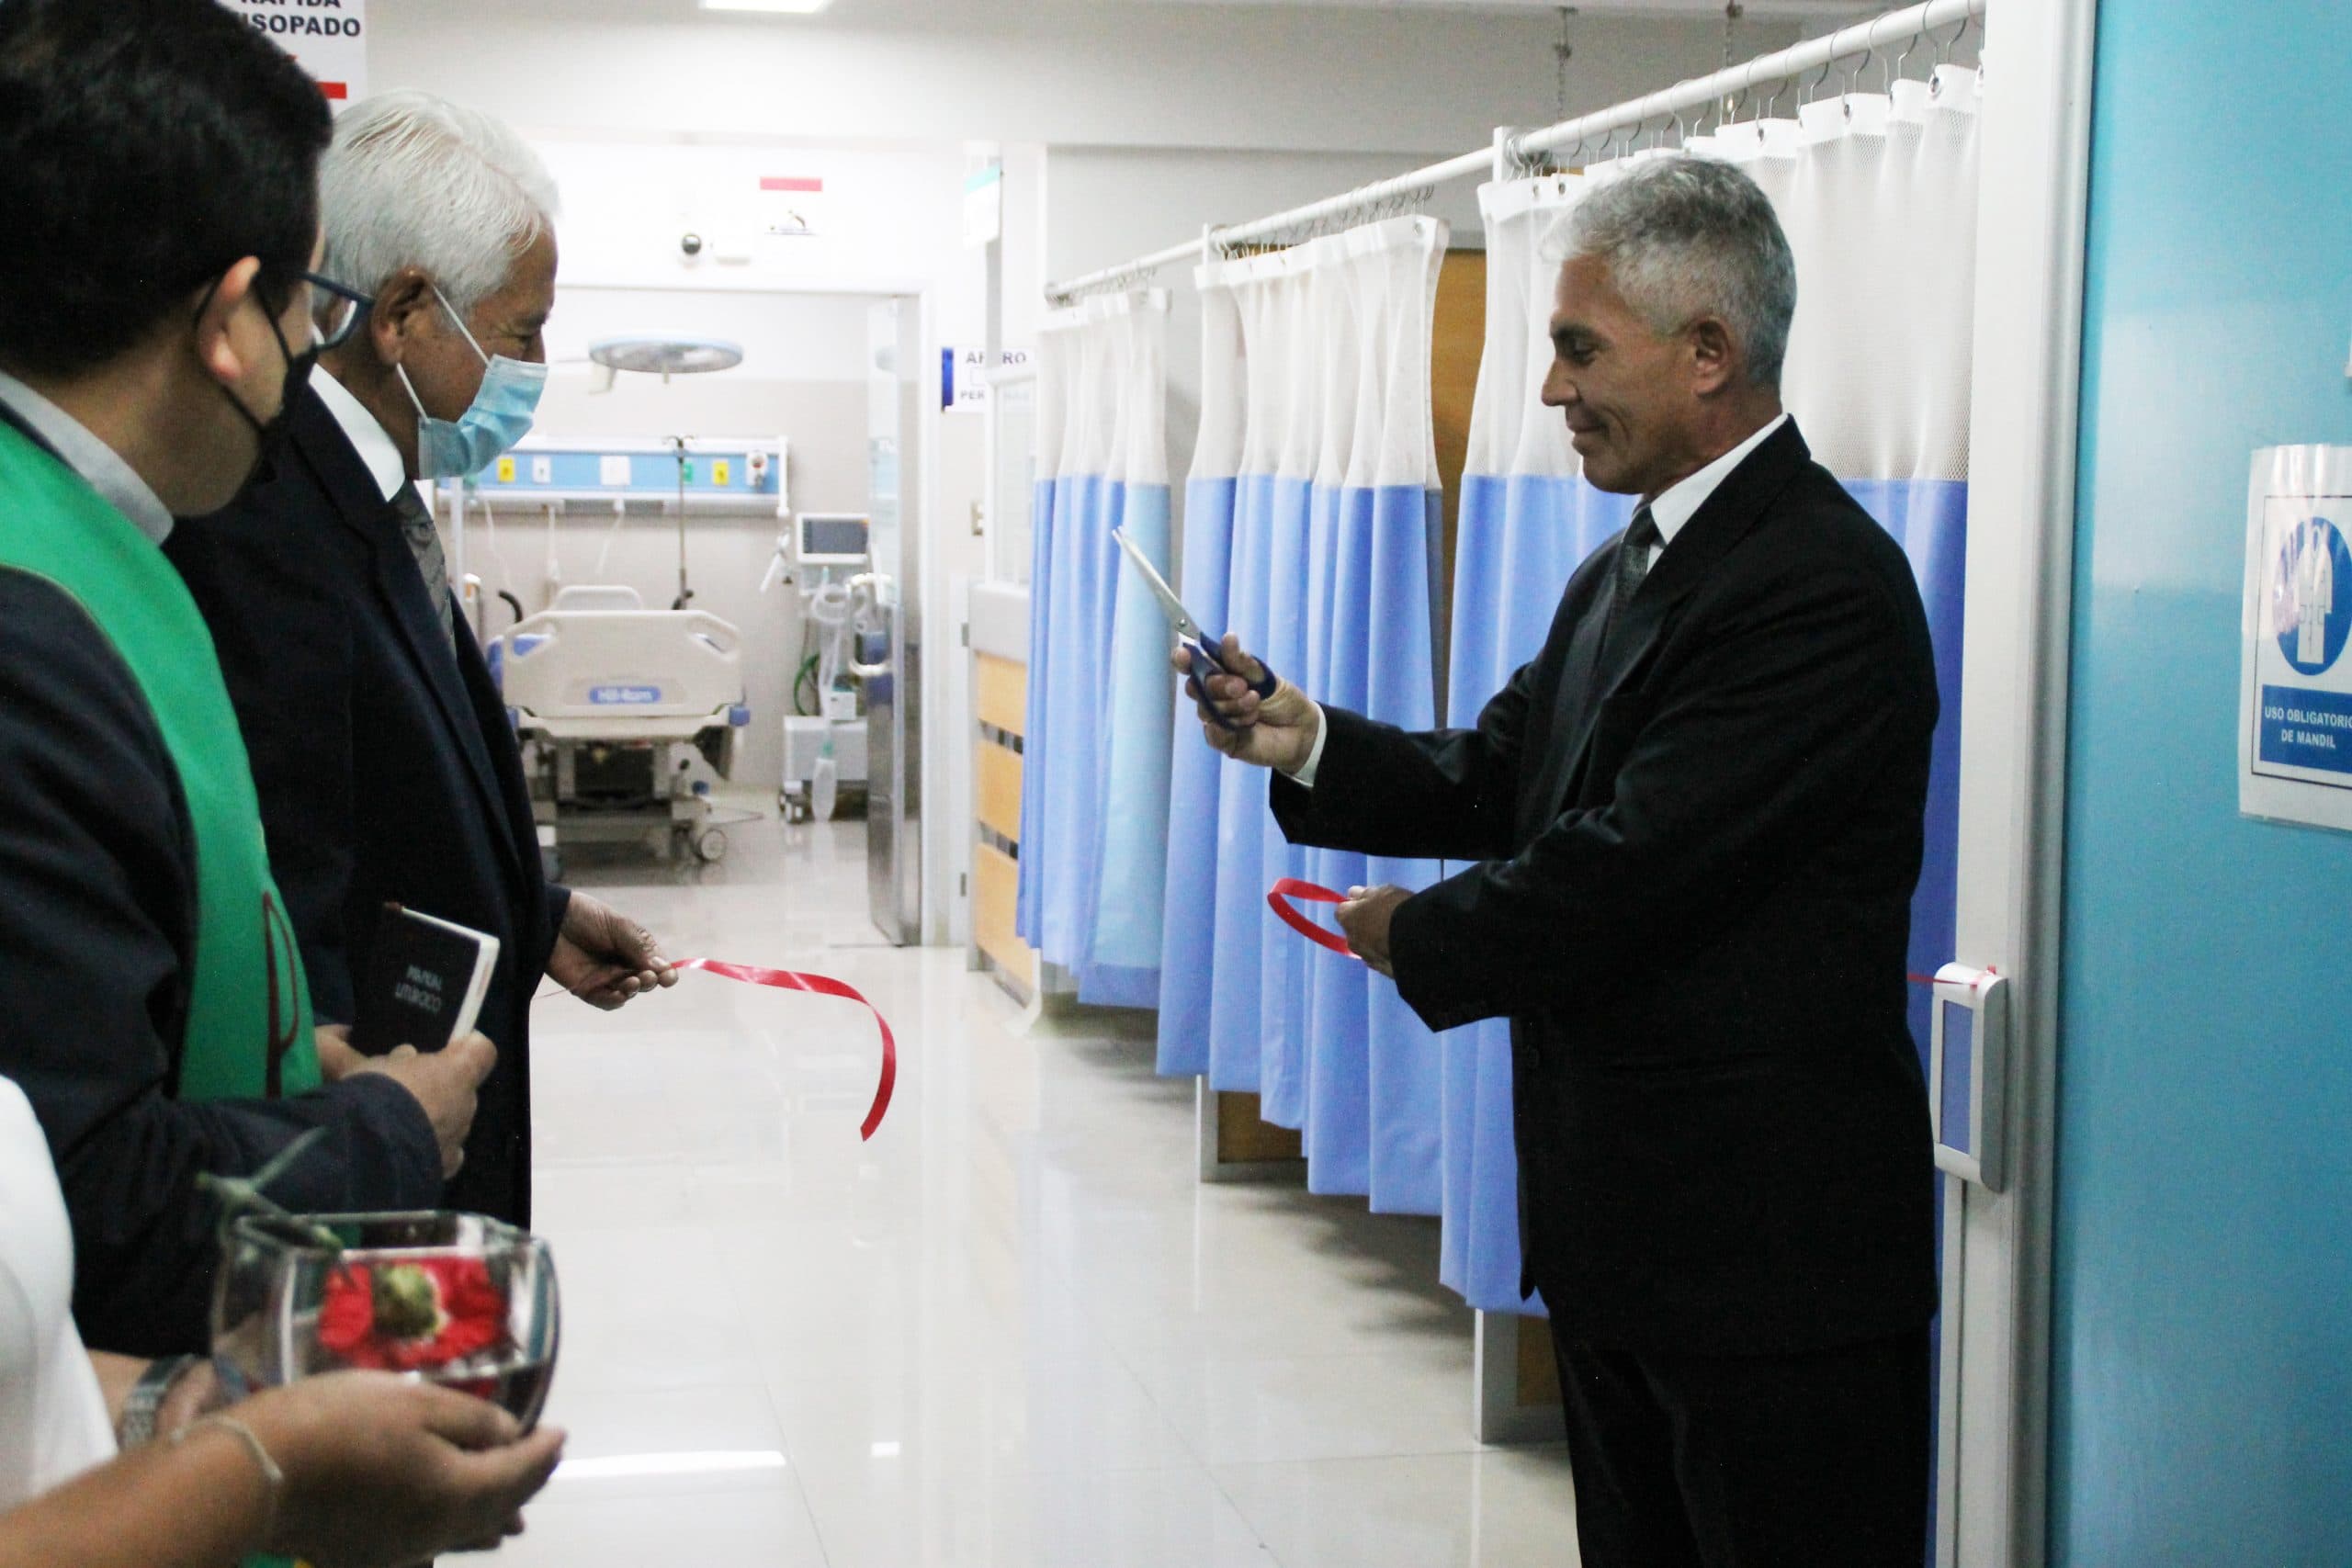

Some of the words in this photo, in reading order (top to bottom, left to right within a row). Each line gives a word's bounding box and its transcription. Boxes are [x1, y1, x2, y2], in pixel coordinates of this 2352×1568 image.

[2265, 705, 2284, 719] USO
[2281, 729, 2294, 743] DE
[2297, 731, 2336, 750] MANDIL
